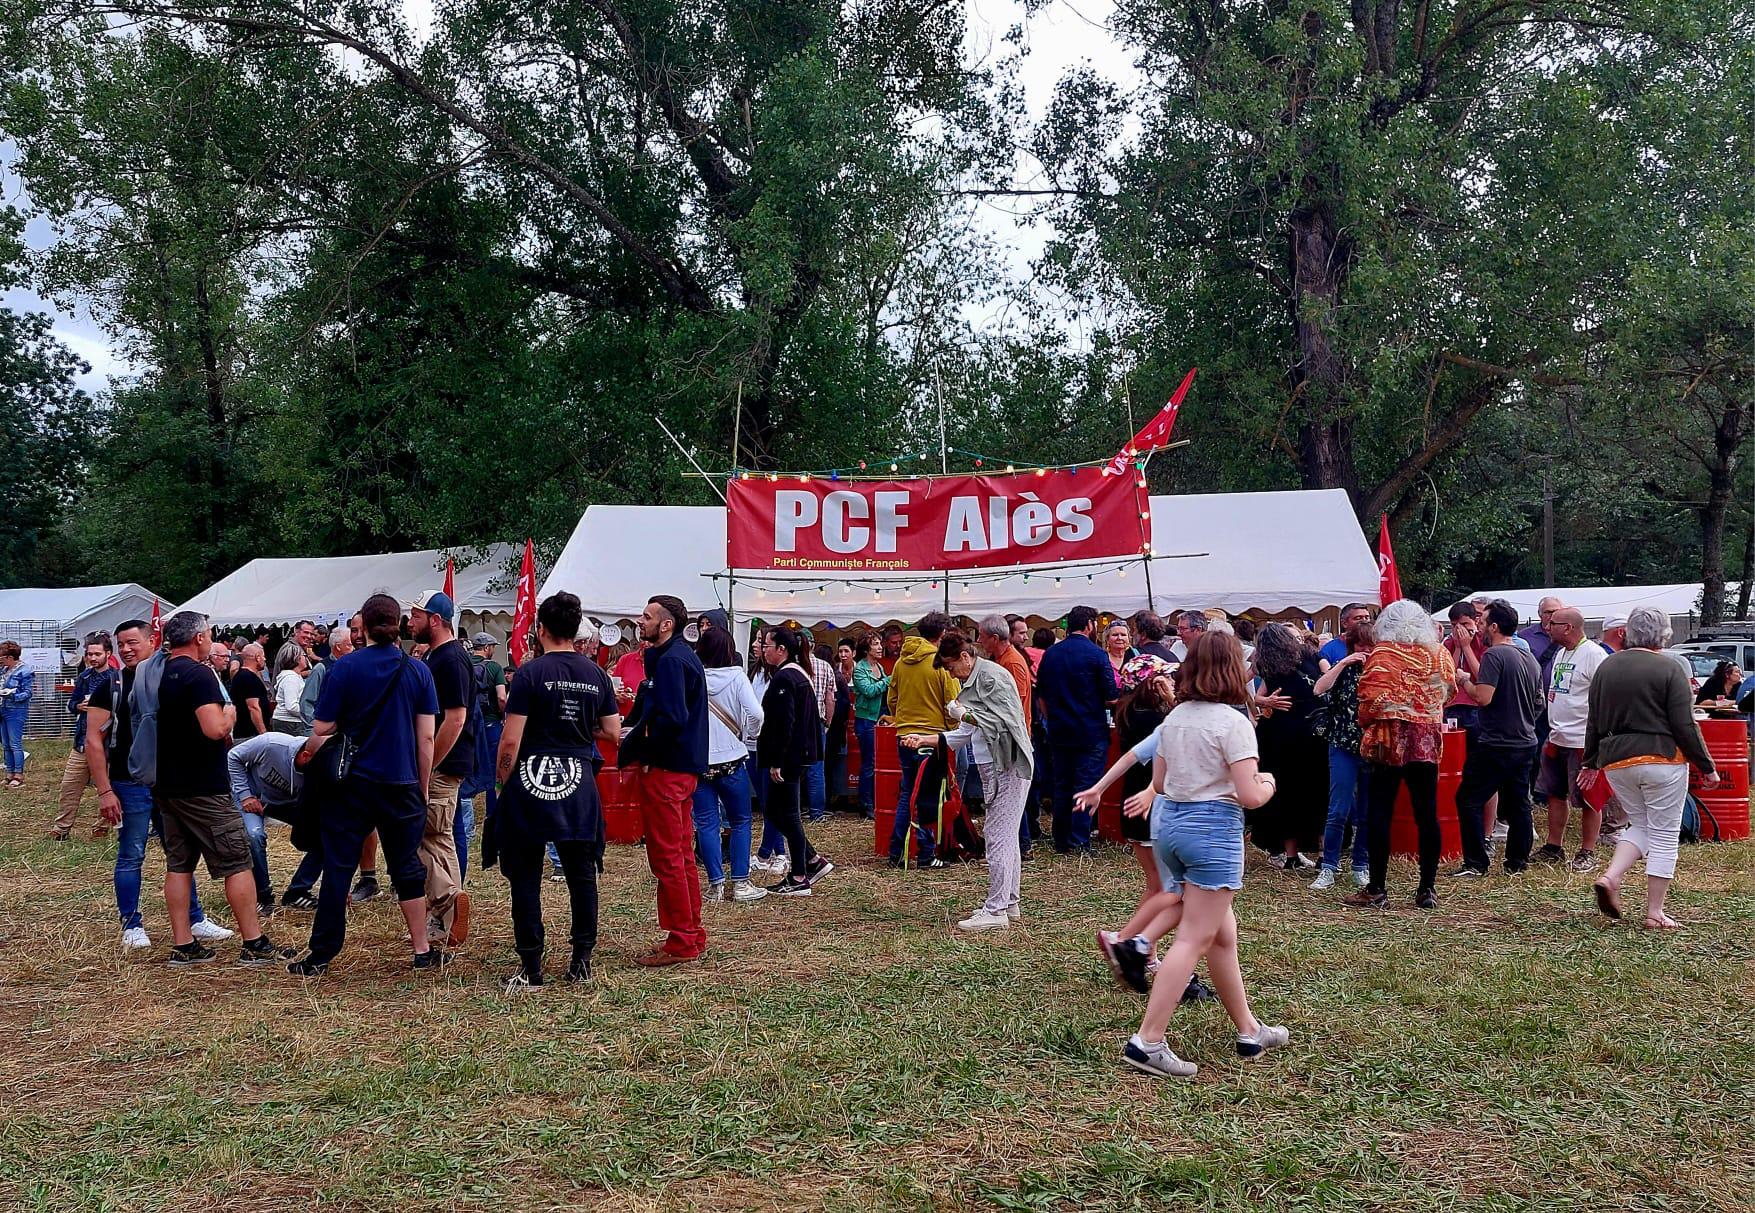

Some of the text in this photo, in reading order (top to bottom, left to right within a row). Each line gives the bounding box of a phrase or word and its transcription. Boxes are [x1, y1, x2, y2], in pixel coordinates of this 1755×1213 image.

[774, 489, 1094, 554] PCF Alès
[773, 557, 910, 569] Parti Communiste Français
[530, 782, 577, 800] LIBERATION
